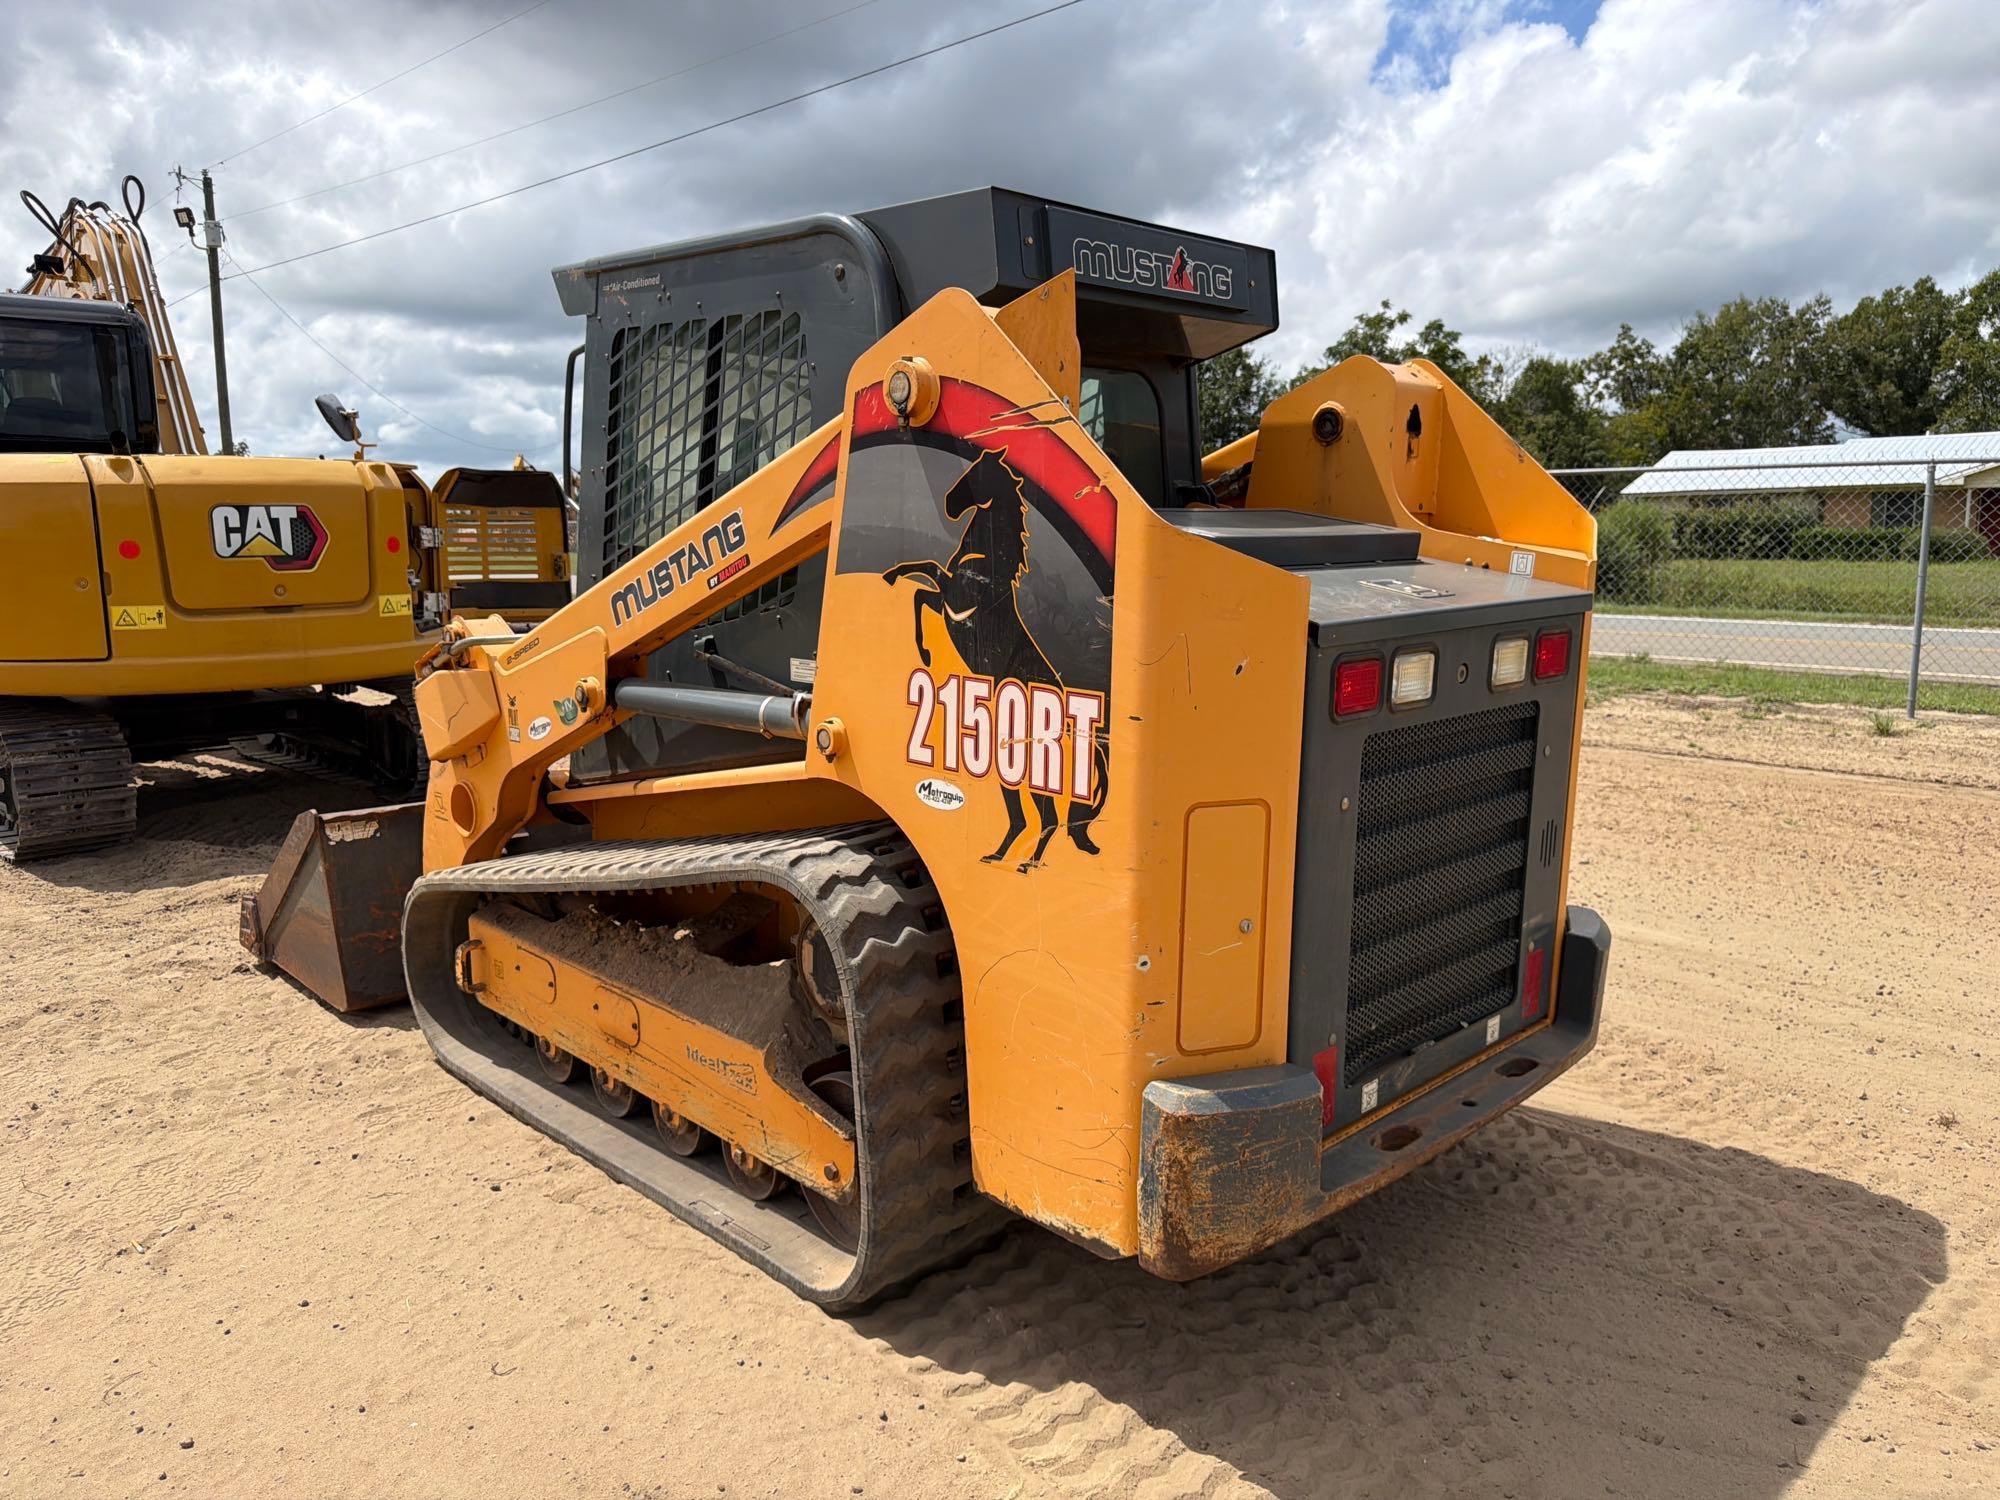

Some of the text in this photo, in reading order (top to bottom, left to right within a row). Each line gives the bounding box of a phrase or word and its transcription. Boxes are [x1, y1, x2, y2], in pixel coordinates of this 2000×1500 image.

[1073, 238, 1233, 300] MUSTANG
[212, 506, 298, 558] CAT
[610, 510, 746, 628] MUSTANG
[709, 556, 748, 588] BY MANITOU
[507, 637, 540, 665] 2-SPEED
[907, 668, 1102, 800] 2150RT
